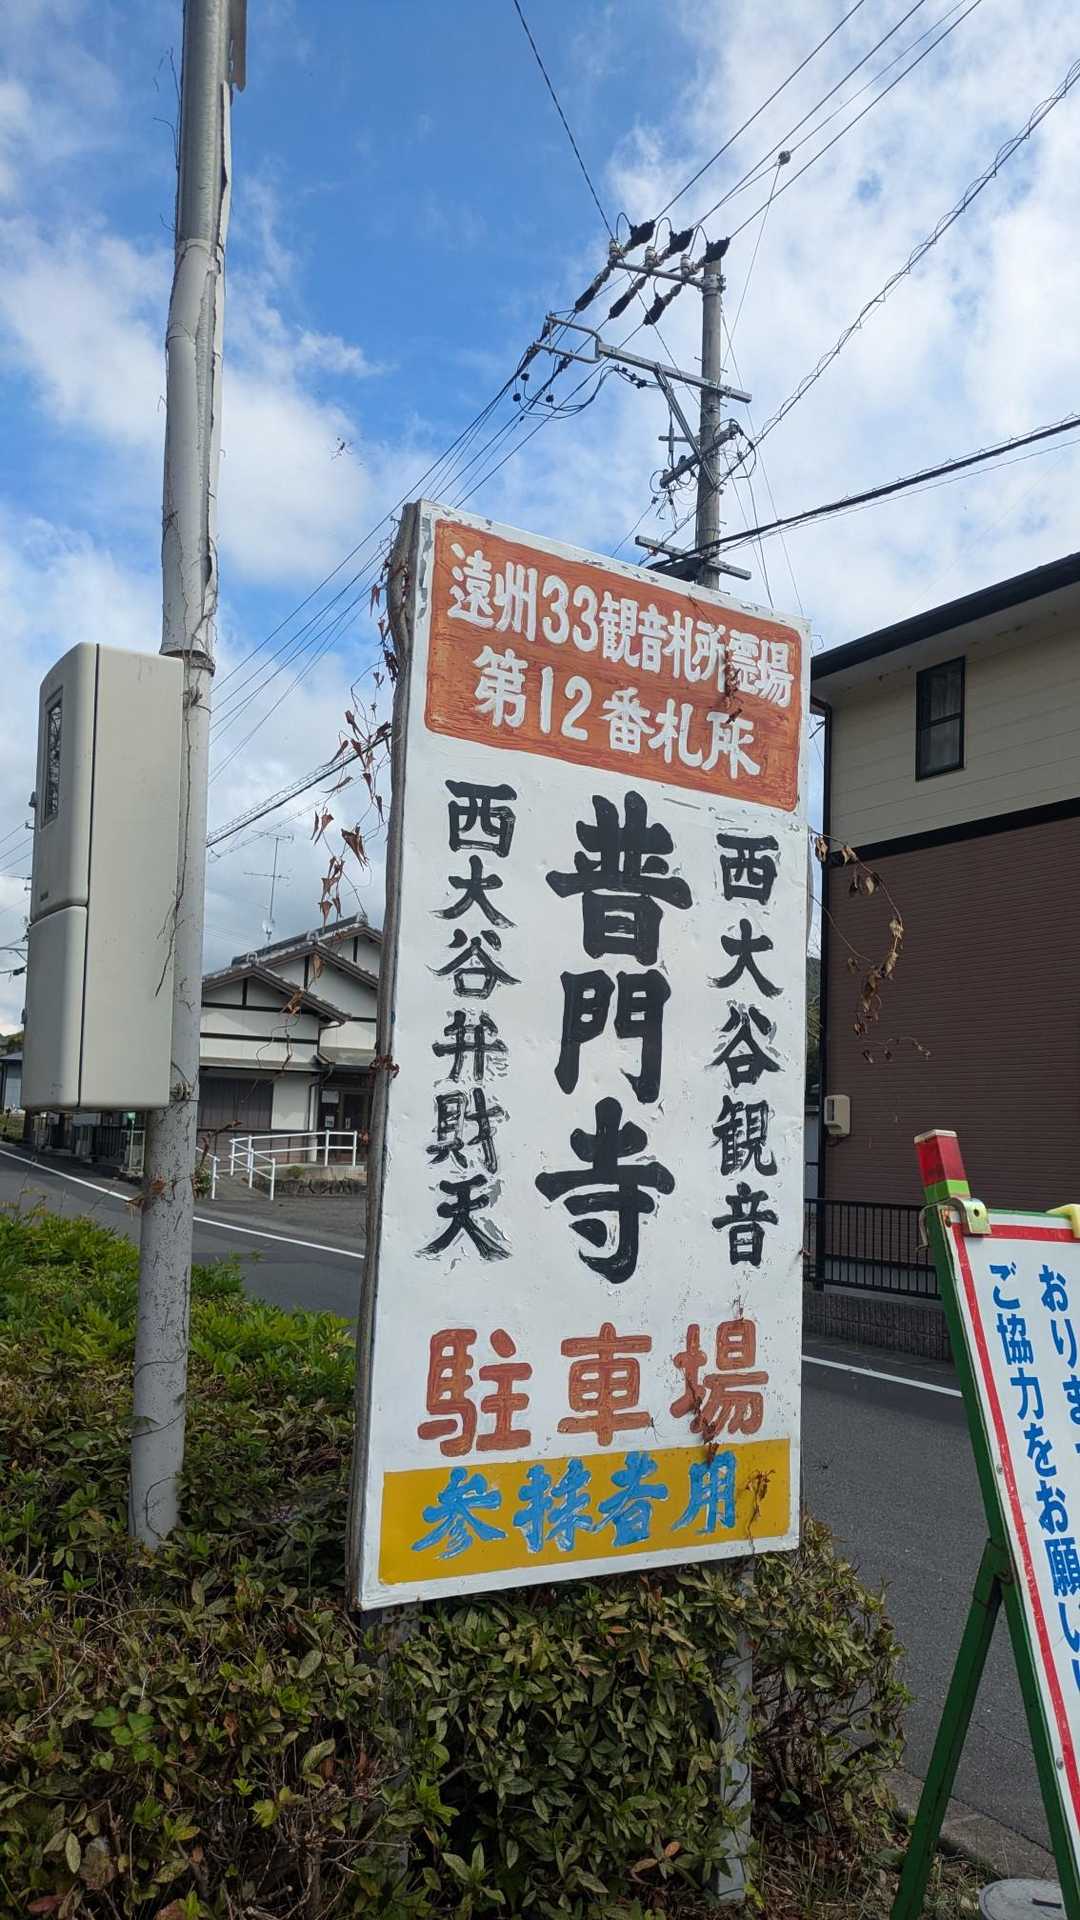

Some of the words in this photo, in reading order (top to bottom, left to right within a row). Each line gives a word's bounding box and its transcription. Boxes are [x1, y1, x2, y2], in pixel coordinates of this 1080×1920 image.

[473, 645, 760, 779] 第12番札所
[535, 790, 692, 1285] 普門寺
[704, 833, 785, 1267] 西大谷観音
[417, 1319, 769, 1457] 駐車場
[1039, 1264, 1080, 1456] おりま
